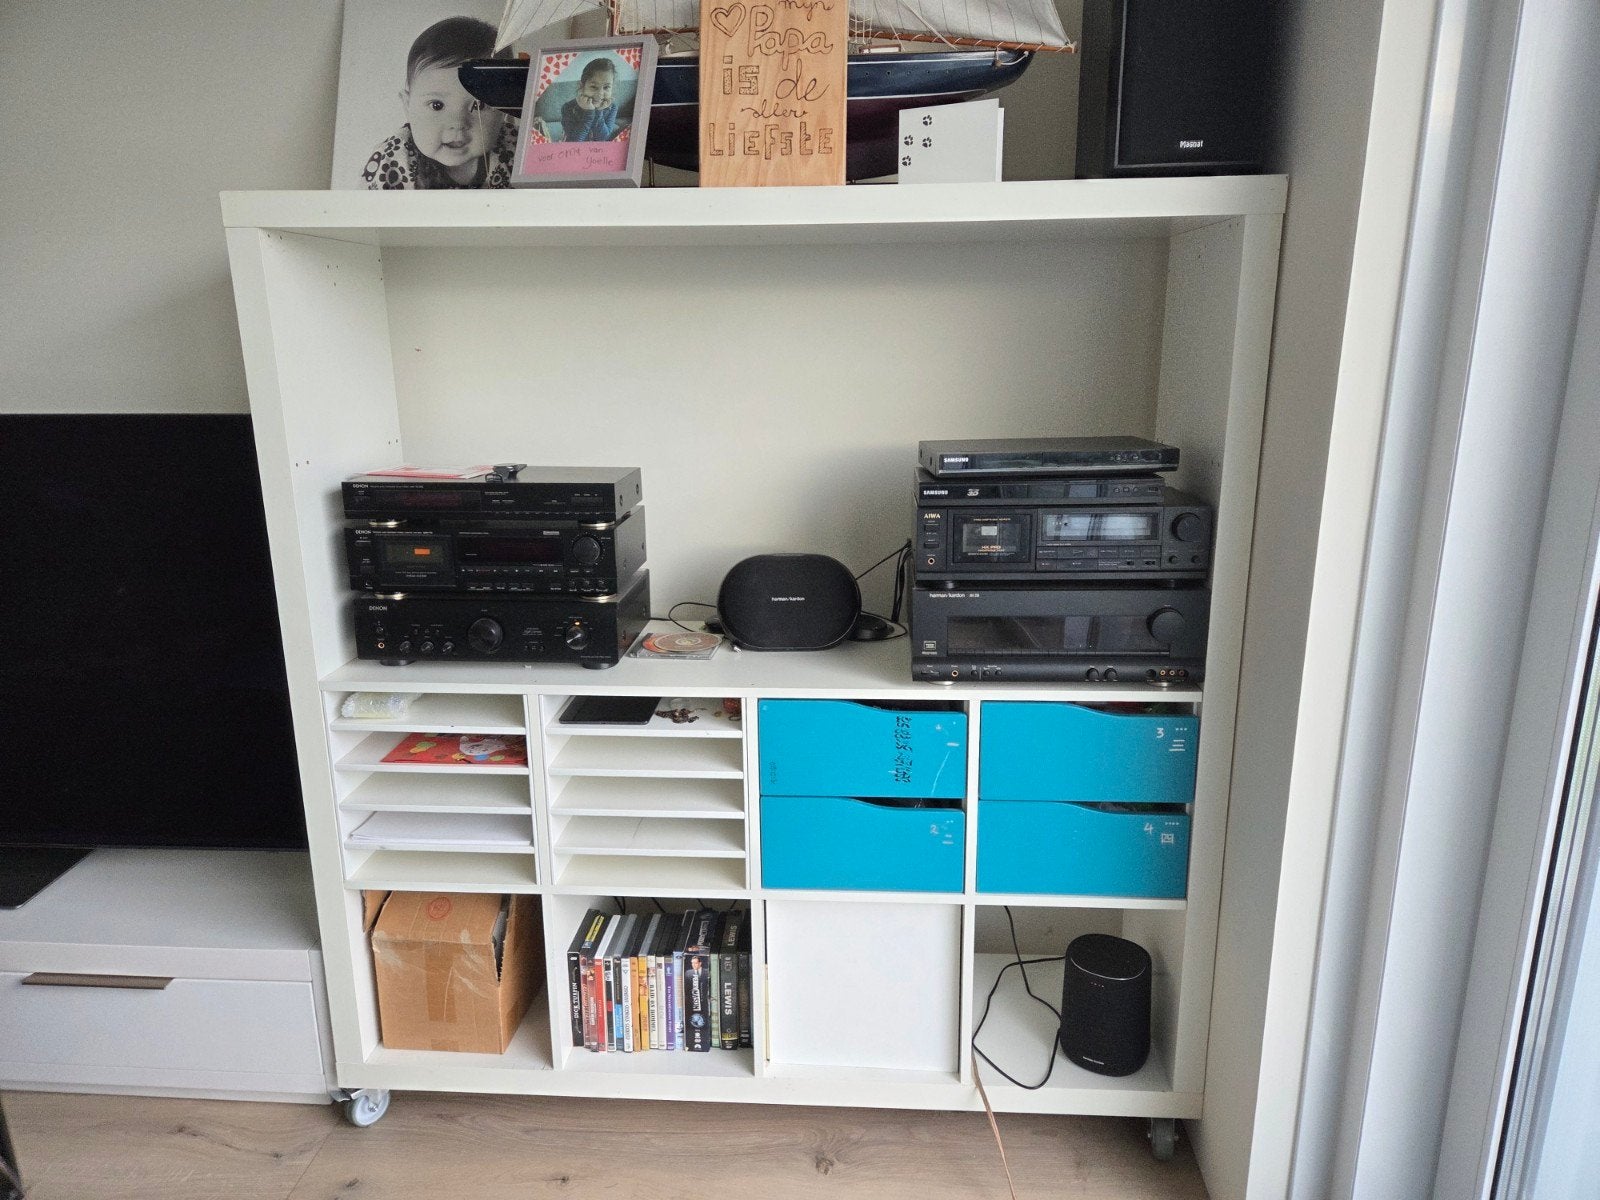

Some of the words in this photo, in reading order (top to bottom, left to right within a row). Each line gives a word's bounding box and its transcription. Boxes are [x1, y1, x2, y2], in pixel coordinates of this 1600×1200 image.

[747, 4, 834, 72] Papa
[722, 55, 760, 95] is
[775, 58, 831, 102] de
[740, 98, 808, 119] aller
[1156, 727, 1164, 738] 3
[1143, 822, 1154, 835] 4
[727, 924, 738, 946] LEWIS
[724, 982, 732, 1015] LEWIS
